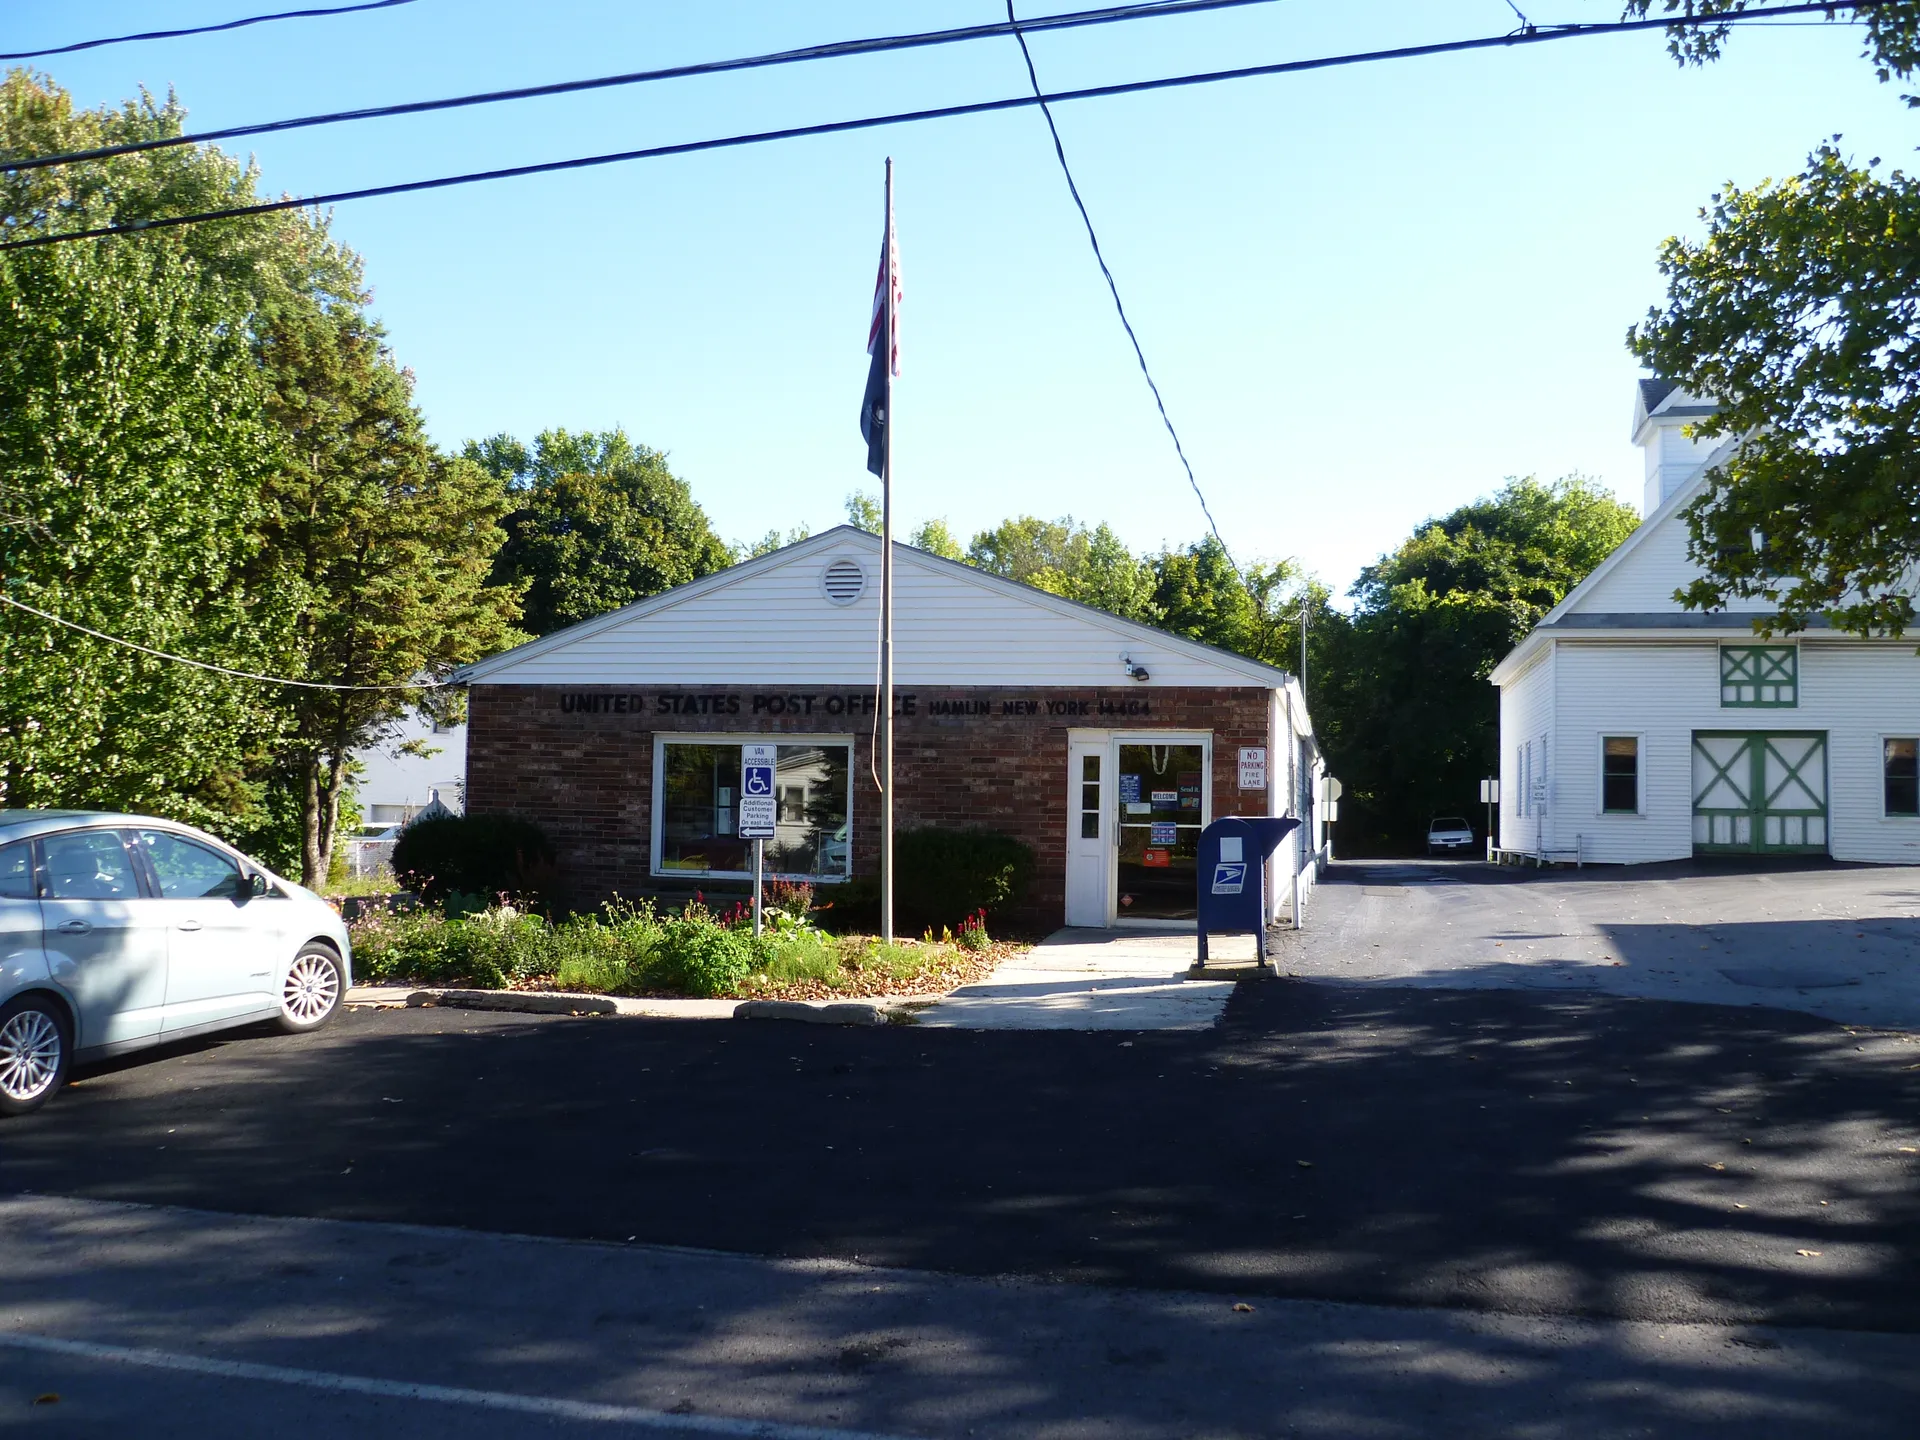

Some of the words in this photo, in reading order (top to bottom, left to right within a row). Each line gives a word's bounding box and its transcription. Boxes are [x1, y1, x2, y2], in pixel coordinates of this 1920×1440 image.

[560, 694, 644, 714] UNITED
[657, 694, 741, 715] STATES
[752, 694, 816, 715] POST
[928, 701, 991, 715] HAMLIN
[1002, 701, 1039, 715] NEW
[1046, 701, 1089, 715] YORK
[1098, 701, 1151, 716] 14464
[754, 747, 764, 755] VAN
[1246, 751, 1258, 760] NO
[744, 757, 774, 766] ACCESSIBLE
[1241, 761, 1264, 770] PARKING
